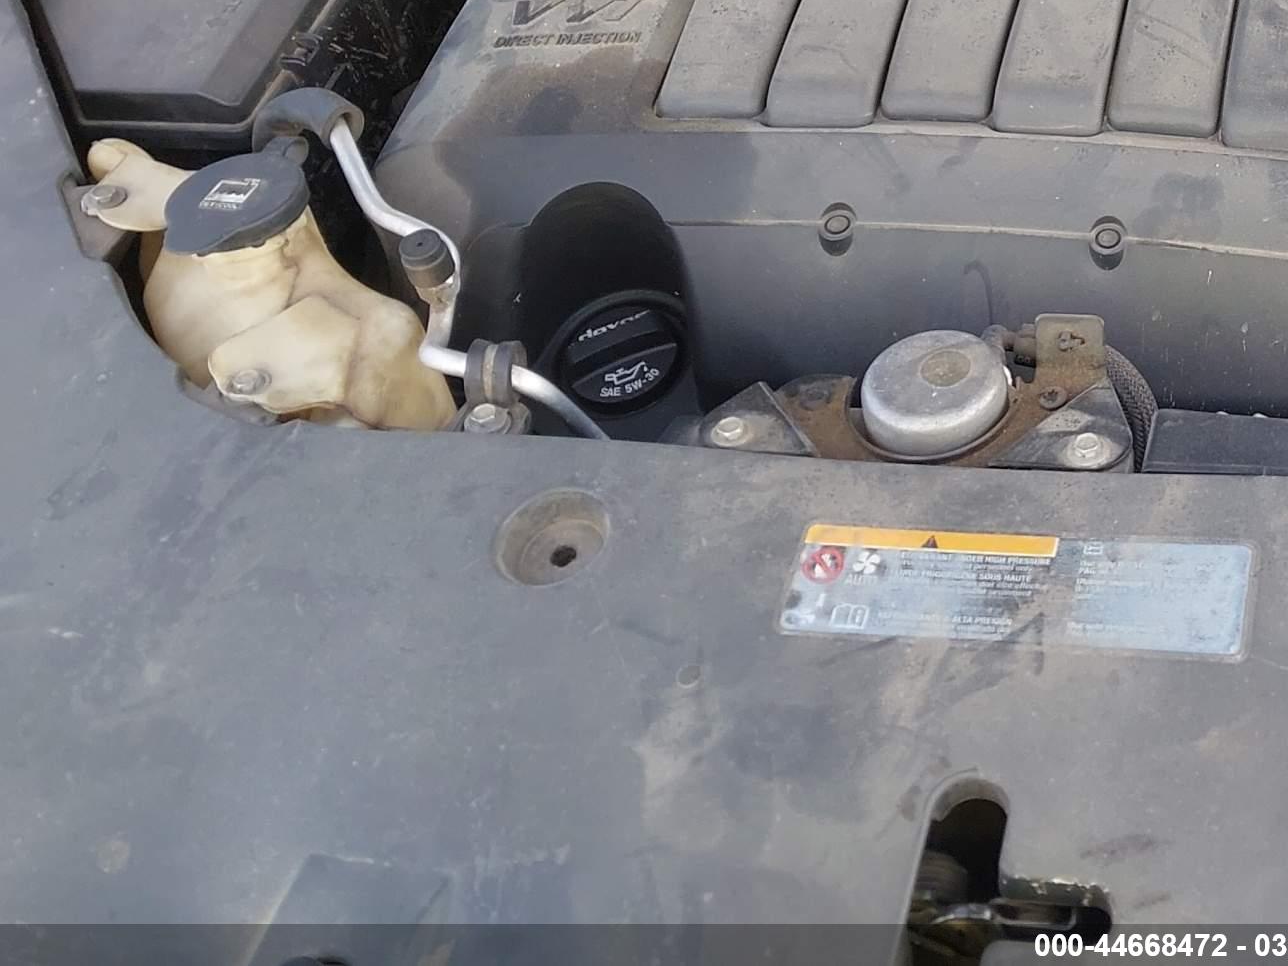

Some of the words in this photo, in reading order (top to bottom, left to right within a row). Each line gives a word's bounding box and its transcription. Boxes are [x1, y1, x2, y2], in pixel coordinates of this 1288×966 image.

[493, 34, 552, 49] DIRECT
[555, 32, 642, 46] INJECTION
[599, 386, 621, 398] SAE
[625, 368, 660, 394] 5W-30
